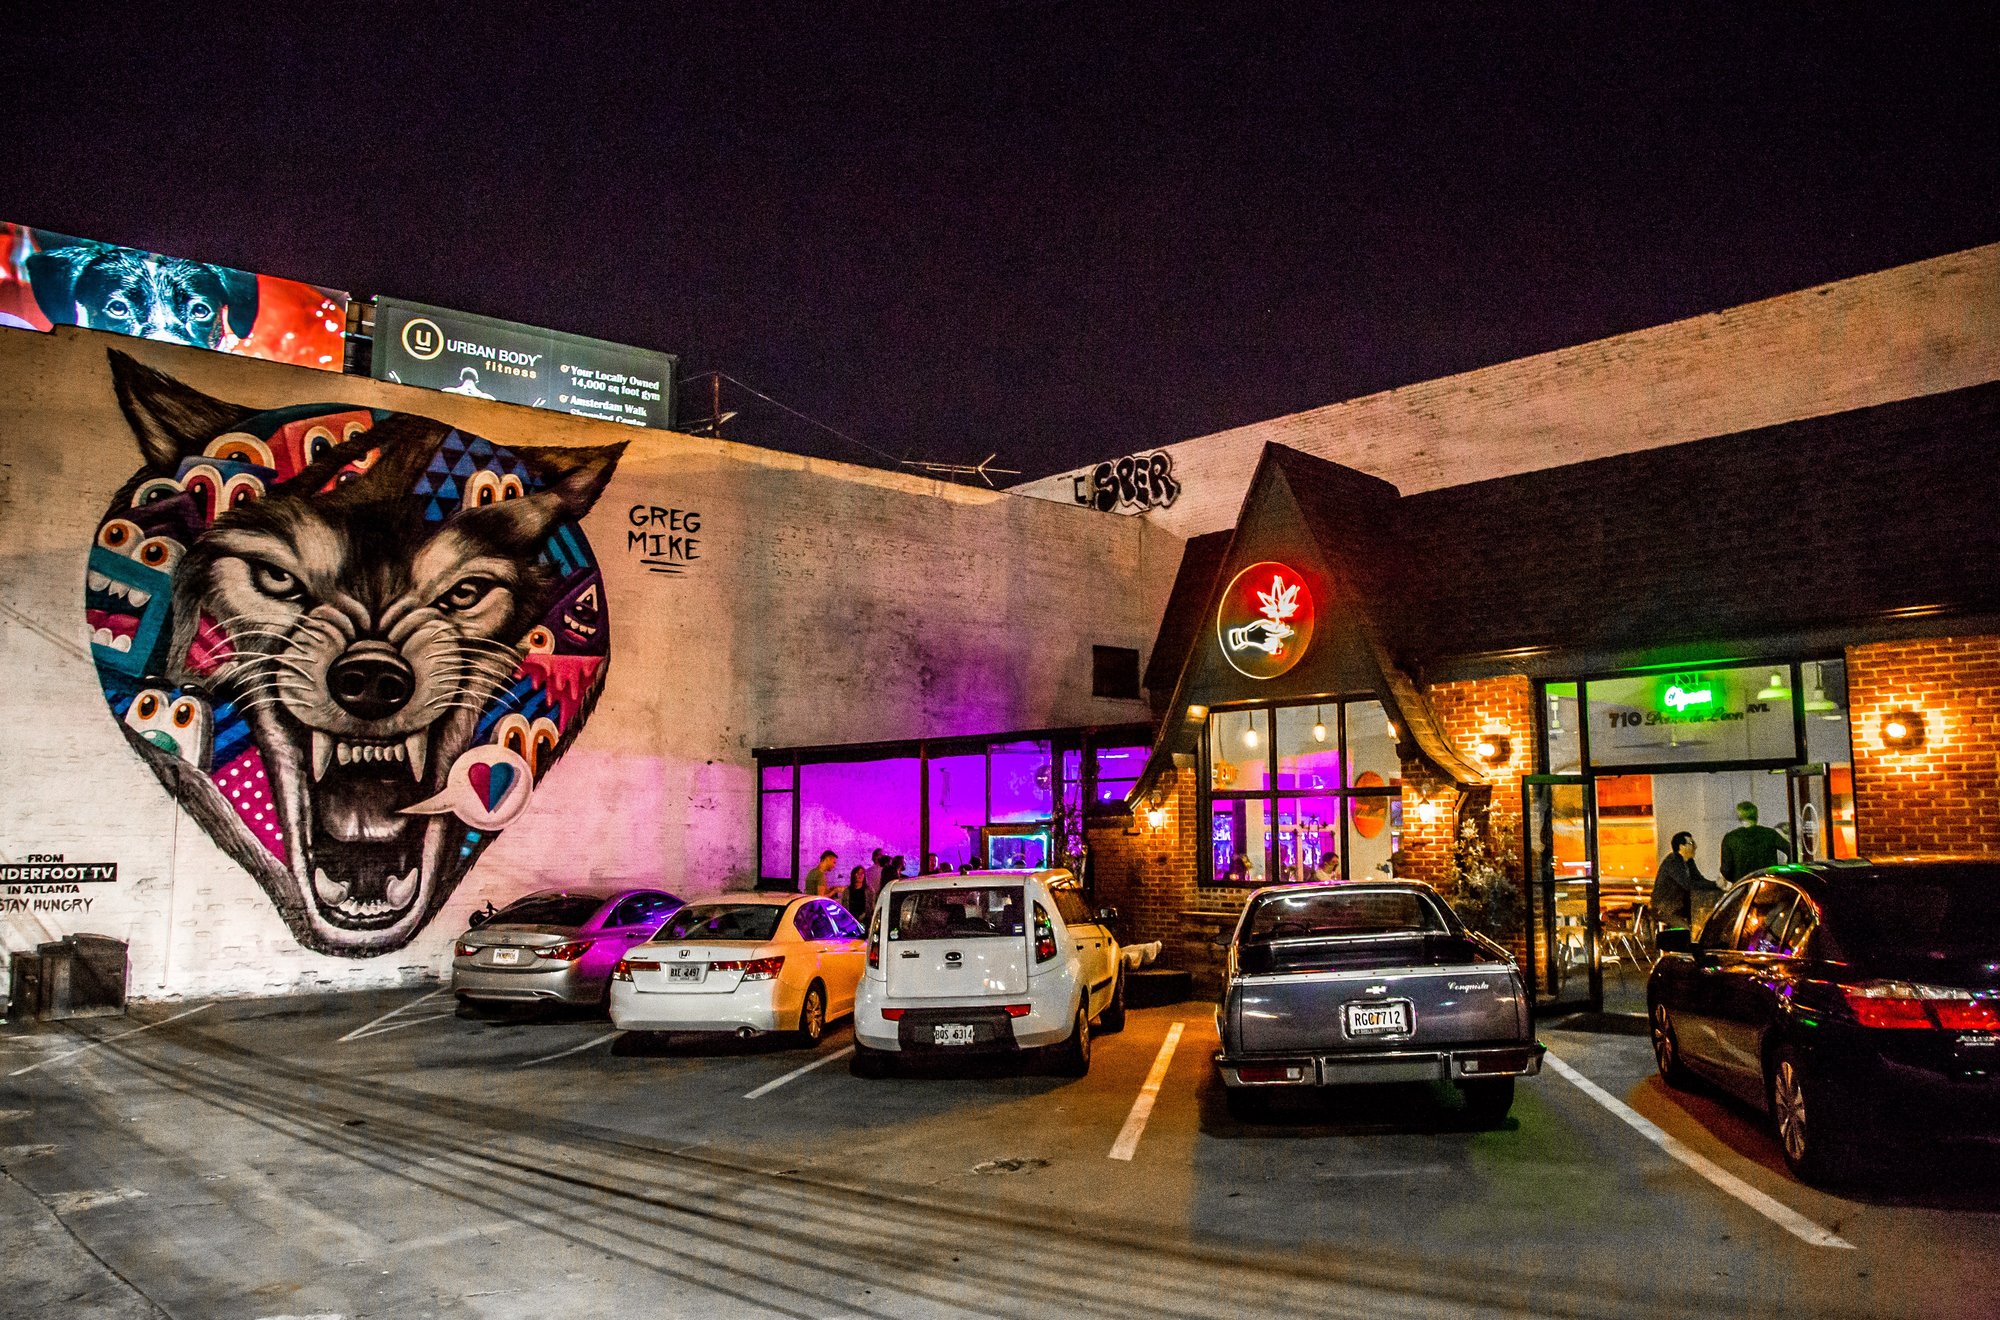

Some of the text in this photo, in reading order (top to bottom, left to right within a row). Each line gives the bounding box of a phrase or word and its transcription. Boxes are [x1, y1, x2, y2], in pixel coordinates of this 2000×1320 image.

[446, 338, 496, 360] URBAN
[484, 360, 537, 379] fitness
[570, 365, 660, 391] Your Locally Owned
[571, 377, 660, 401] 14,000 sq foot gym
[569, 395, 647, 417] Amsterdam Walk
[629, 504, 702, 533] GREG
[627, 530, 702, 560] MIKE
[1609, 711, 1643, 729] 710
[28, 854, 64, 863] FROM
[91, 867, 115, 879] TV
[7, 884, 80, 895] IN ATLANTA
[34, 898, 94, 914] HUNGRY
[1355, 1010, 1401, 1027] RGC7712
